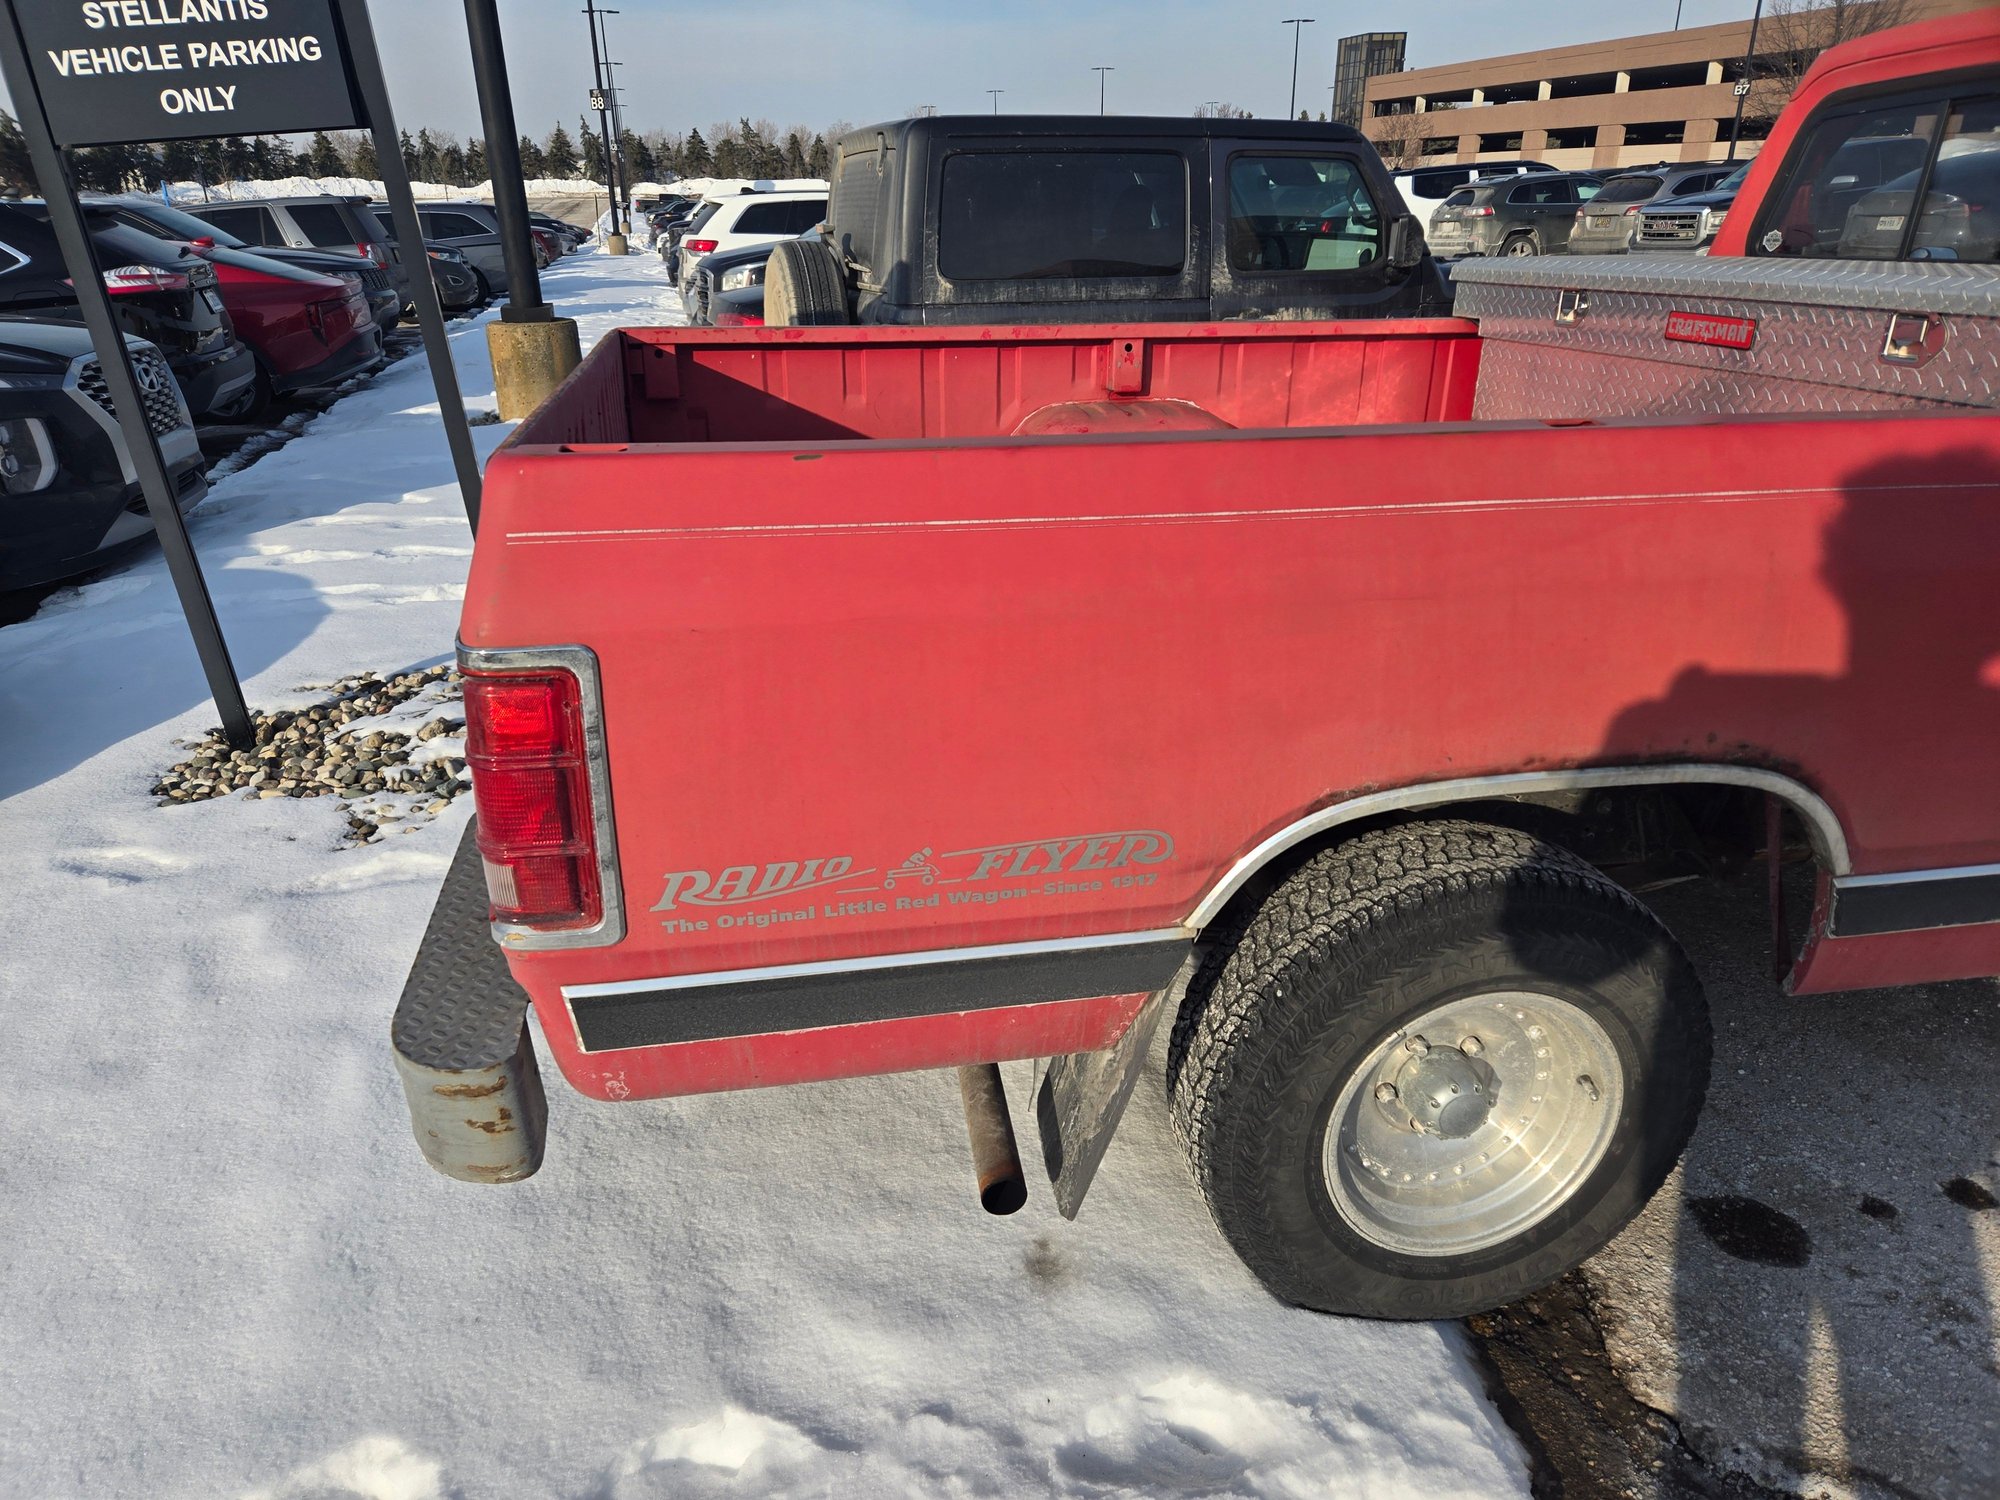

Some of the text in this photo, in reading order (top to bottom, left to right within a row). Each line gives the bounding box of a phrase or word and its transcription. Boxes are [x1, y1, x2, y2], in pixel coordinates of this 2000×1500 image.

[84, 0, 269, 29] STELLANTIS
[48, 36, 322, 77] VEHICLE PARKING
[160, 86, 237, 115] ONLY
[590, 97, 605, 110] B8
[1733, 84, 1750, 96] B7
[1667, 317, 1749, 343] CRAFTSMAN
[649, 829, 1175, 912] RADIO FLYER
[662, 919, 709, 934] The
[716, 906, 816, 928] Original
[824, 899, 887, 918] Little
[896, 893, 940, 911] Red
[1110, 873, 1158, 889] 1917
